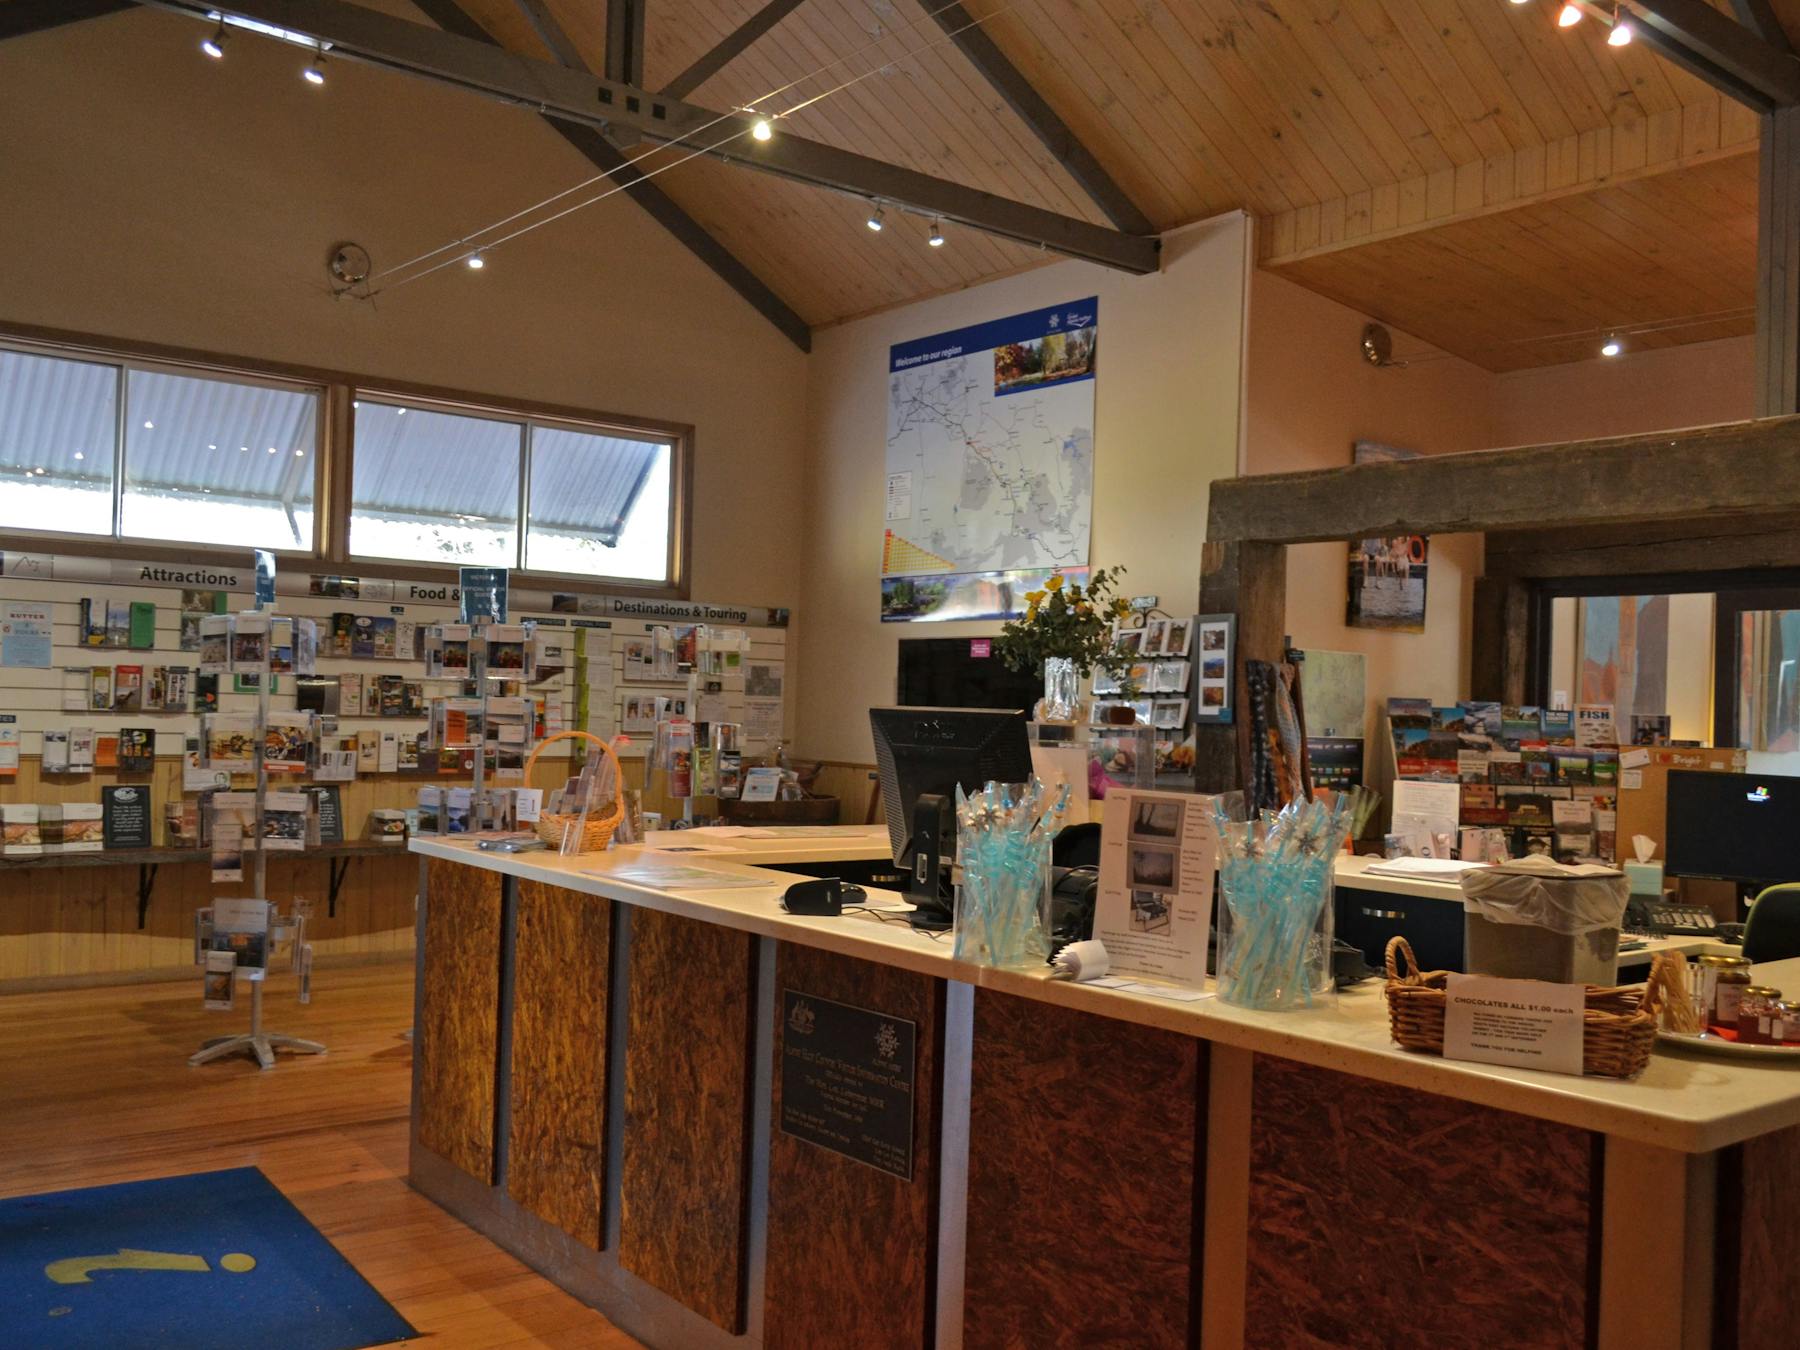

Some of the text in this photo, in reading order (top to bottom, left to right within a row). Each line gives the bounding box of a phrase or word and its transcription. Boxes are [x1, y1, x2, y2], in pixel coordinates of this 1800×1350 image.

[895, 355, 921, 367] Welcome
[930, 351, 941, 359] our
[941, 346, 963, 358] region
[140, 566, 238, 586] Attractions
[410, 586, 460, 601] Food &
[614, 599, 747, 623] Destinations & Touring
[1580, 711, 1610, 719] FISH
[1454, 996, 1509, 1009] CHOCOLATES
[1528, 1004, 1552, 1013] $1.00
[1553, 1007, 1574, 1015] each
